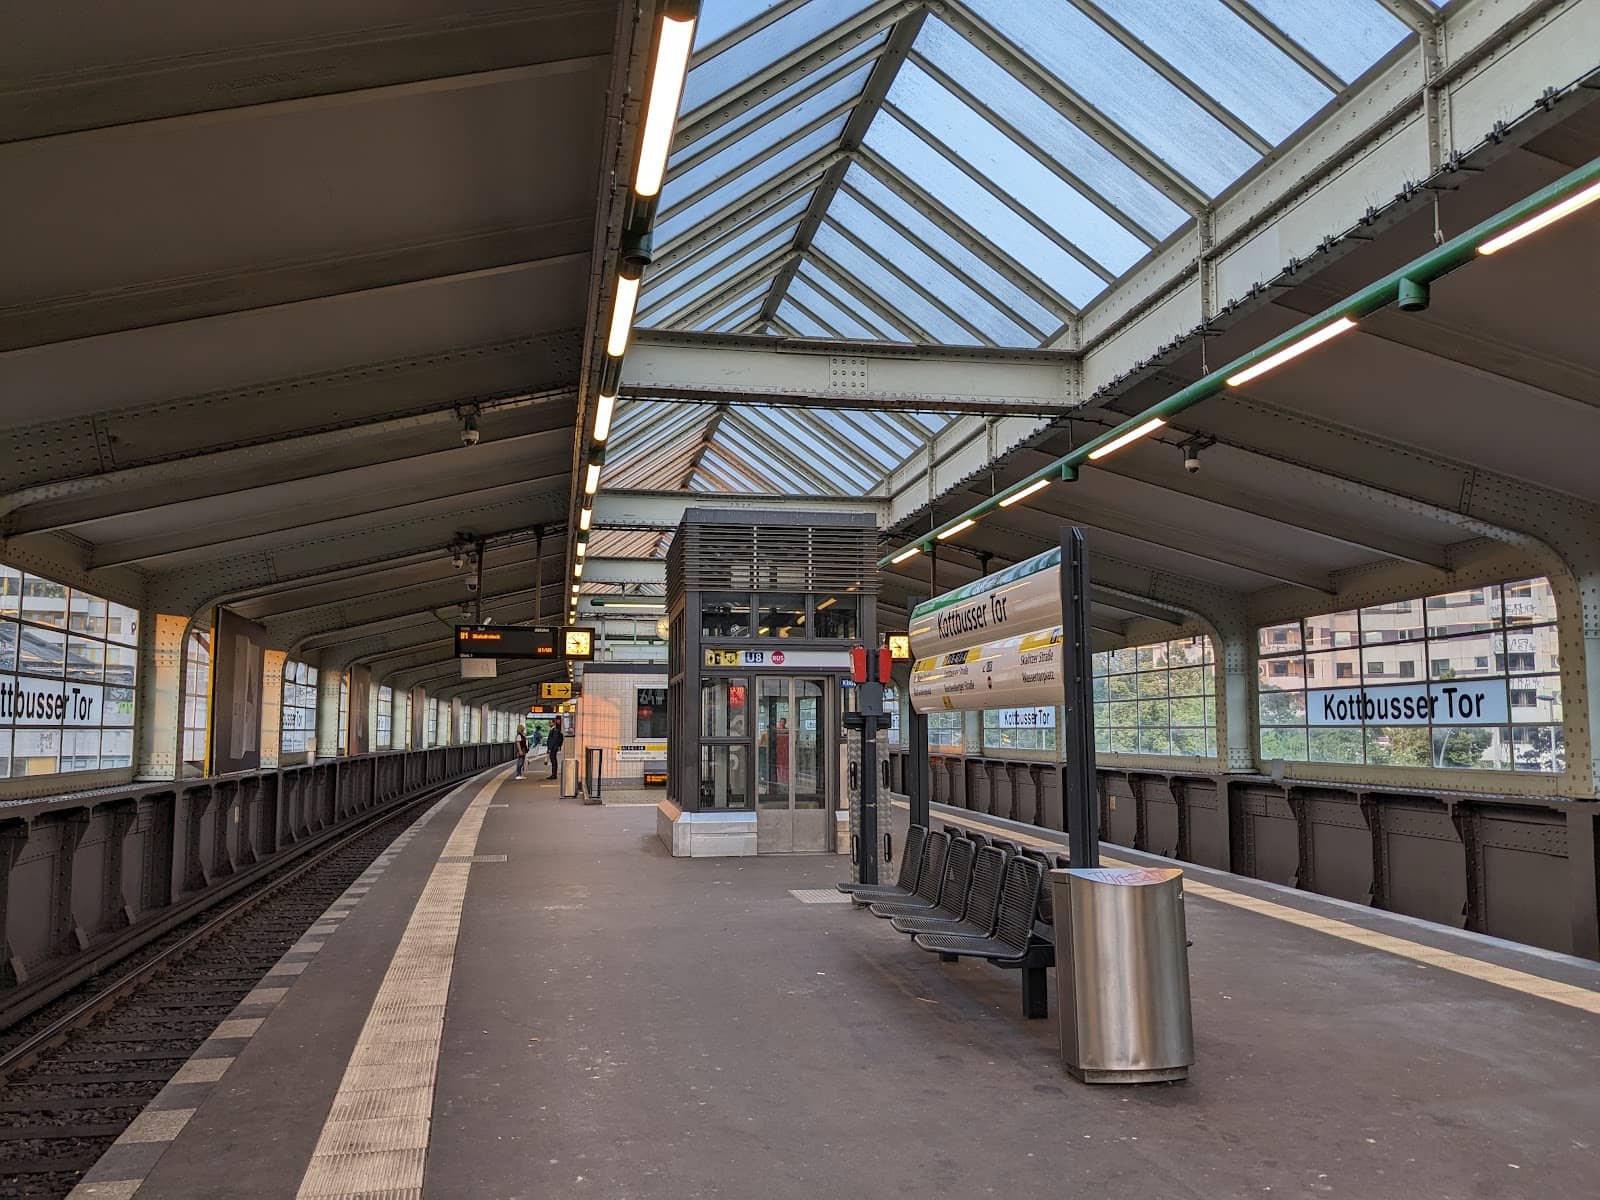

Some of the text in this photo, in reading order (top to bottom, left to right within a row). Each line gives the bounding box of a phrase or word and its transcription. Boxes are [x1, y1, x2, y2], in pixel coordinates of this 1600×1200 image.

[938, 595, 1008, 639] Kottbusser Tor
[747, 652, 763, 663] U8
[72, 687, 94, 721] Tor
[1004, 710, 1050, 725] Kottbusser Tor
[1323, 688, 1485, 721] Kottbusser Tor
